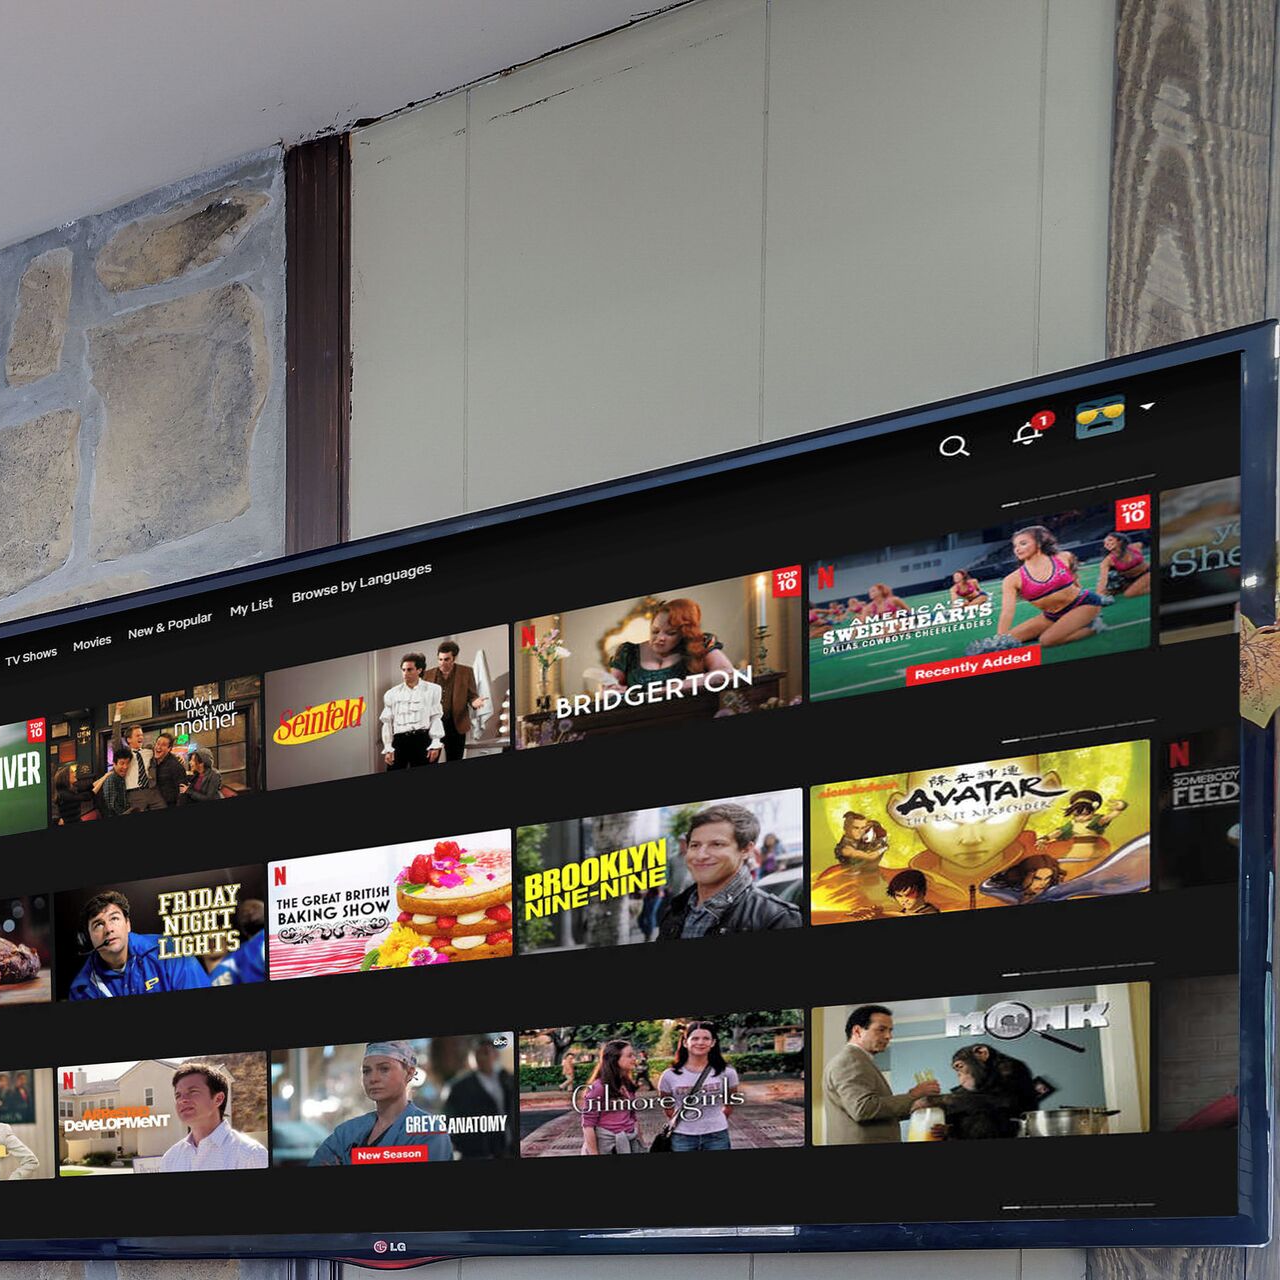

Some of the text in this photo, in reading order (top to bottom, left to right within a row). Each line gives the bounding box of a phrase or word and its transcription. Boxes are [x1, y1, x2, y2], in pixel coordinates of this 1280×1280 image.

[1039, 415, 1048, 426] 1
[1121, 500, 1147, 511] TOP
[1122, 509, 1145, 524] 10
[292, 562, 433, 603] Browse by Languages
[777, 570, 798, 580] TOP
[778, 578, 797, 591] 10
[230, 597, 274, 618] My List
[850, 598, 964, 627] AMERICA'S
[128, 611, 213, 639] New & Popular
[823, 602, 993, 646] SWEETHEARTS
[823, 618, 993, 655] DALLAS COWBOYS CHEERLEADERS
[73, 634, 112, 652] Movies
[5, 647, 58, 667] TV Shows
[915, 650, 1033, 680] Recently Added
[175, 696, 204, 712] how
[556, 665, 753, 719] BRIDGERTON
[187, 700, 236, 719] met your
[278, 696, 365, 740] Seinfeld
[30, 721, 44, 730] TOP
[31, 727, 44, 739] 10
[174, 710, 238, 737] mother
[1173, 770, 1240, 788] SOMEBODY
[896, 777, 1069, 816] AVATAR
[1173, 781, 1240, 806] FEED
[906, 816, 928, 826] THE
[971, 801, 1053, 818] AIRBENDER
[525, 838, 668, 903] BROOKLYN
[158, 883, 241, 916] FRIDAY
[276, 886, 390, 910] THE GREAT BRITISH
[525, 866, 668, 921] NINE-NINE
[162, 907, 236, 936] NIGHT
[278, 899, 391, 926] BAKING SHOW
[158, 929, 241, 961] LIGHTS
[493, 1037, 508, 1047] abc
[572, 1077, 745, 1122] Gilmore girls
[406, 1114, 508, 1134] GREY'S ANATOMY
[358, 1150, 422, 1161] New Season
[390, 1242, 407, 1252] LG
